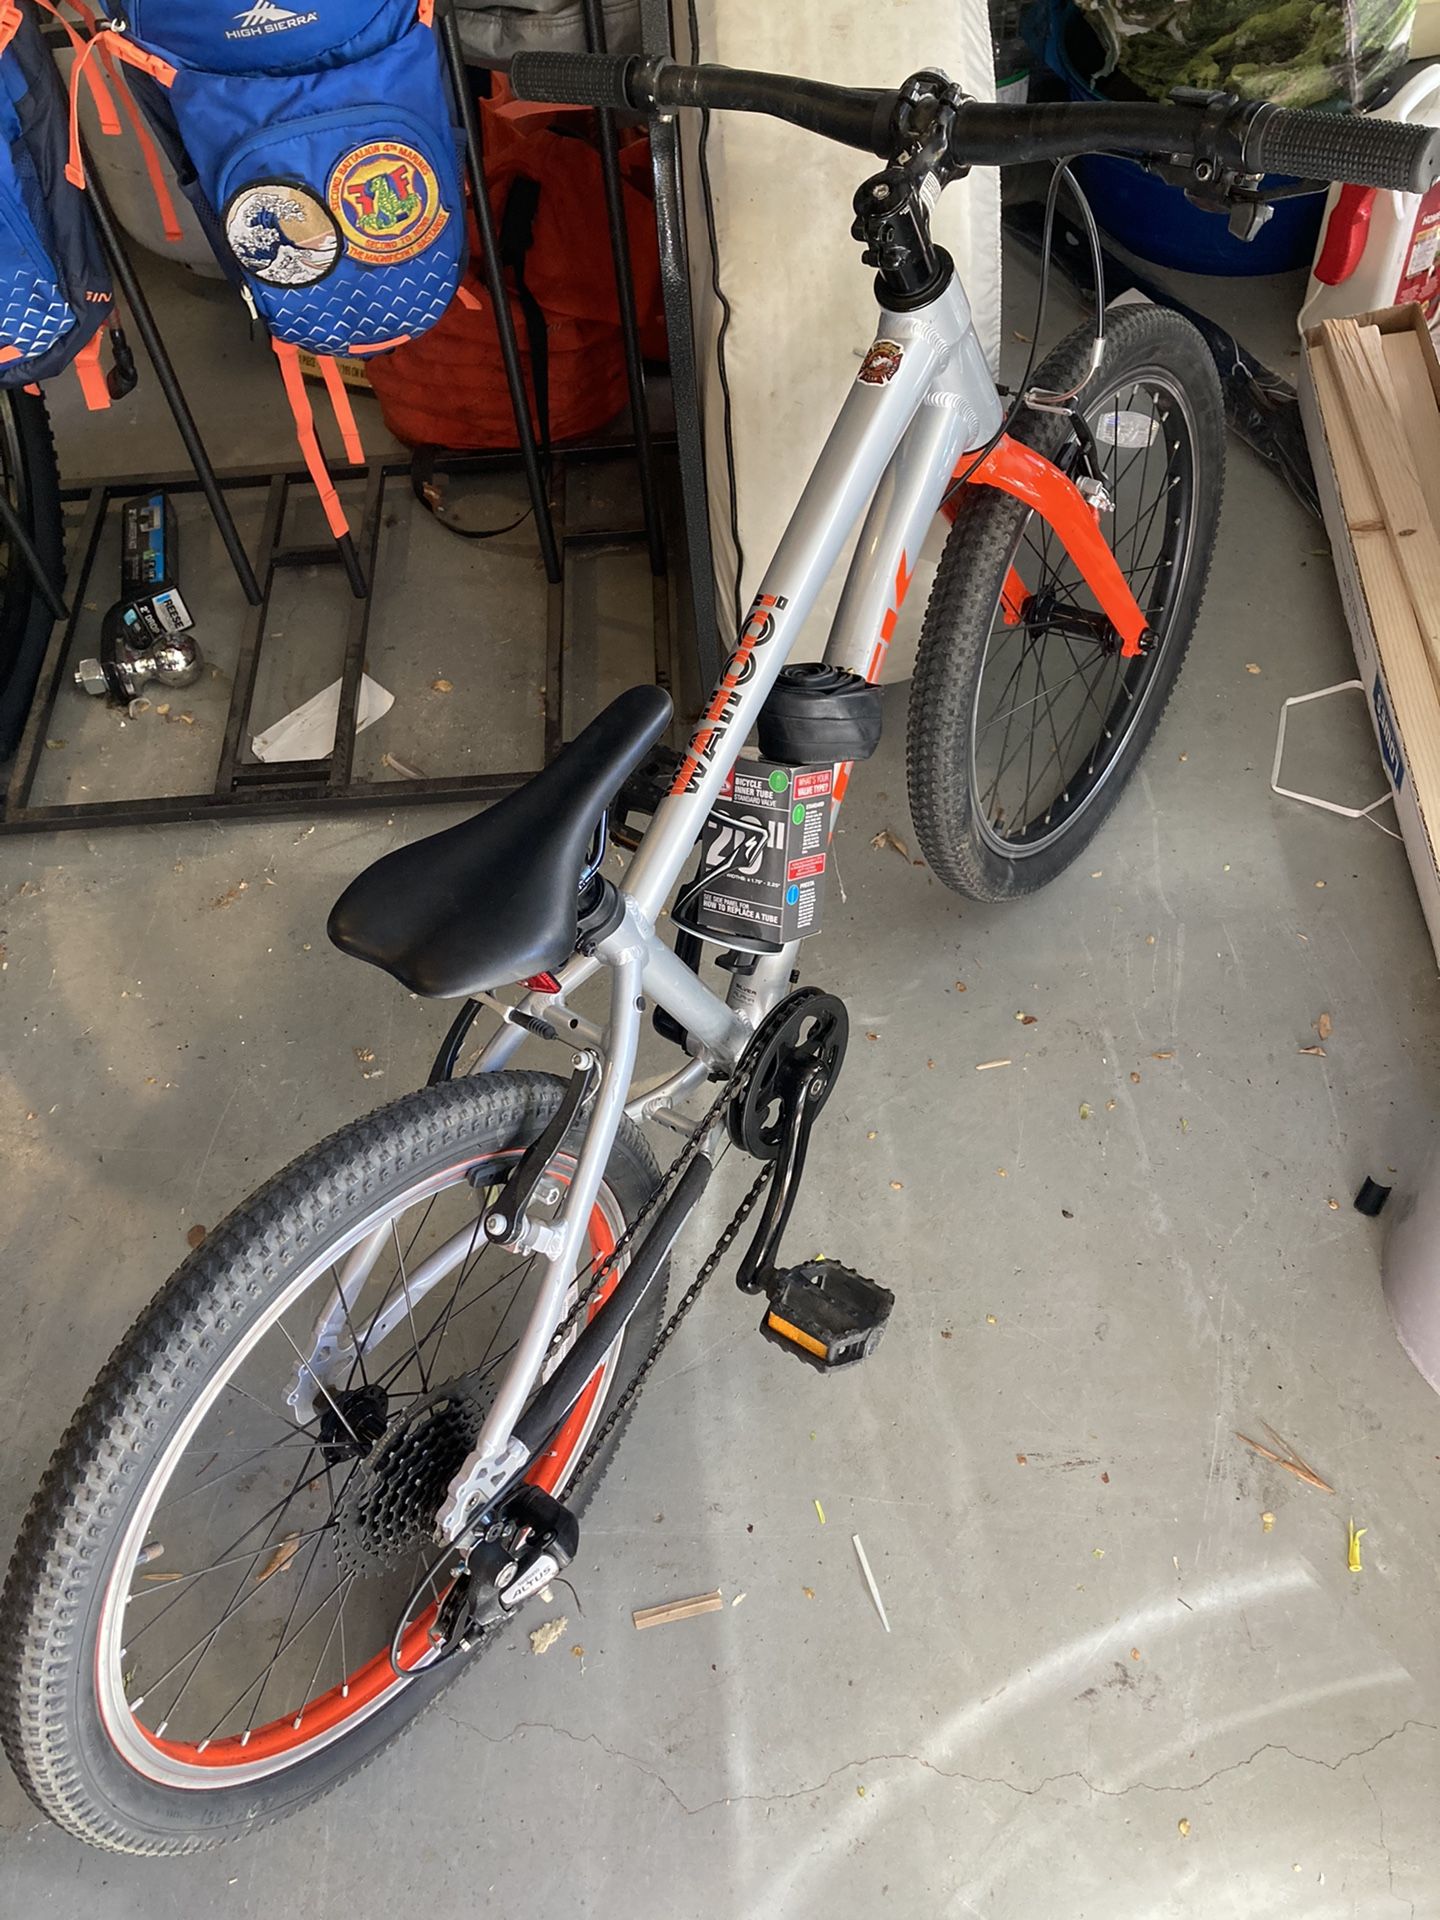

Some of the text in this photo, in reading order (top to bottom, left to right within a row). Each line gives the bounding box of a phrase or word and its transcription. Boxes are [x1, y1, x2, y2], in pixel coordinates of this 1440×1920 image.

[225, 12, 318, 39] HIGH SIERRA
[329, 176, 341, 211] SECOND
[398, 146, 430, 176] MARINES
[416, 212, 447, 249] BASTARDS
[365, 239, 398, 249] SECOND
[400, 235, 412, 245] TO
[144, 614, 161, 635] DROP
[164, 599, 185, 629] REESE
[735, 777, 762, 789] BICYCLE
[735, 785, 754, 797] INNER
[756, 789, 774, 800] TUBE
[734, 793, 776, 807] STANDARD VALVE
[703, 900, 778, 924] HOW TO REPLACE A TUBE
[724, 899, 738, 907] PANEL
[512, 1566, 551, 1599] ALTUS
